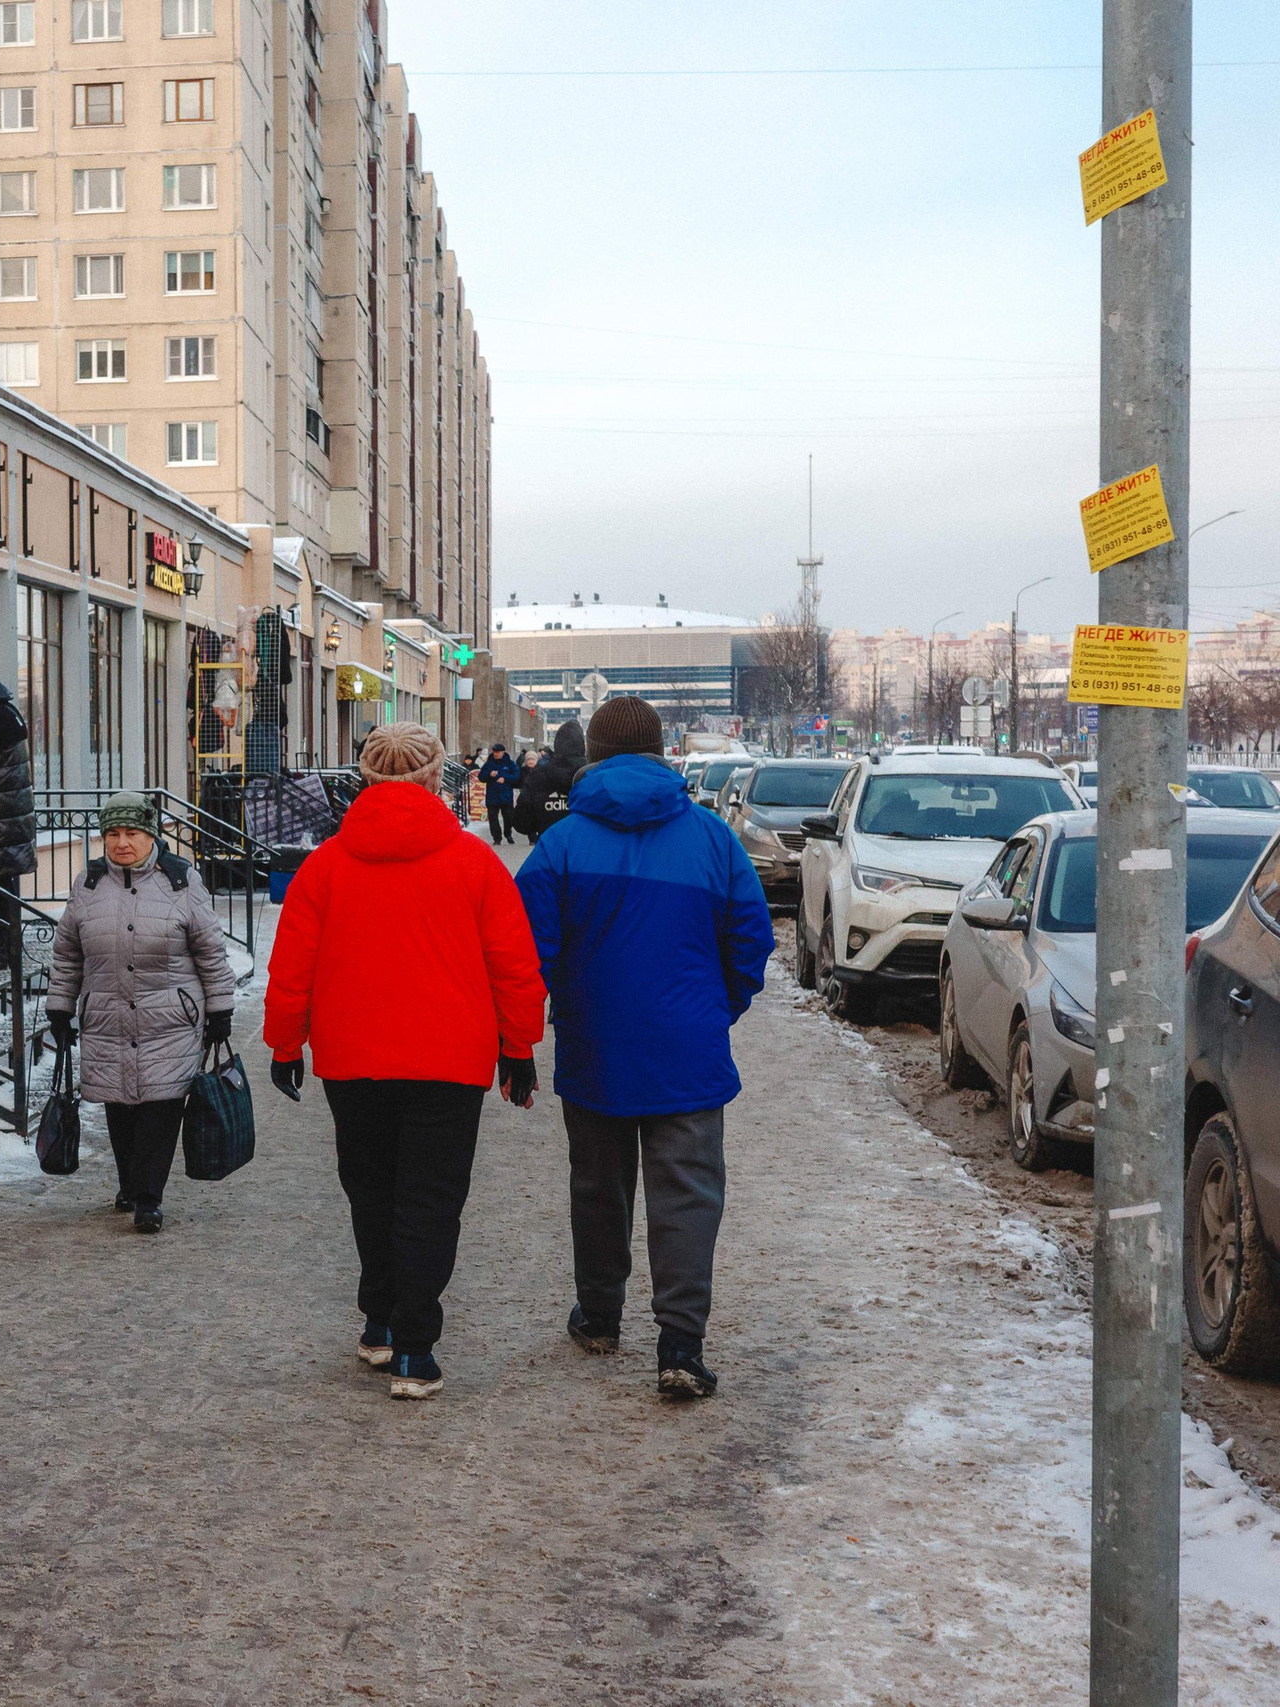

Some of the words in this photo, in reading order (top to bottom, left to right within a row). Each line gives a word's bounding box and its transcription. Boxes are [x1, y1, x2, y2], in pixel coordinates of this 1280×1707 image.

[1080, 137, 1109, 166] НЕГДЕ
[1111, 112, 1153, 144] ЖИТЬ?
[1091, 199, 1097, 208] 8
[1098, 186, 1117, 204] (931)
[1118, 161, 1162, 192] 951-48-69
[1081, 487, 1114, 513] НЕГДЕ
[1115, 467, 1157, 496] ЖИТЬ?
[1096, 548, 1102, 557] 8
[1102, 537, 1122, 554] (931)
[1122, 518, 1168, 544] 951-48-69
[1076, 627, 1125, 643] НЕГДЕ
[1128, 629, 1186, 644] ЖИТЬ?
[1082, 680, 1089, 688] 8
[1092, 680, 1119, 690] (931)
[1121, 682, 1181, 694] 951-48-69
